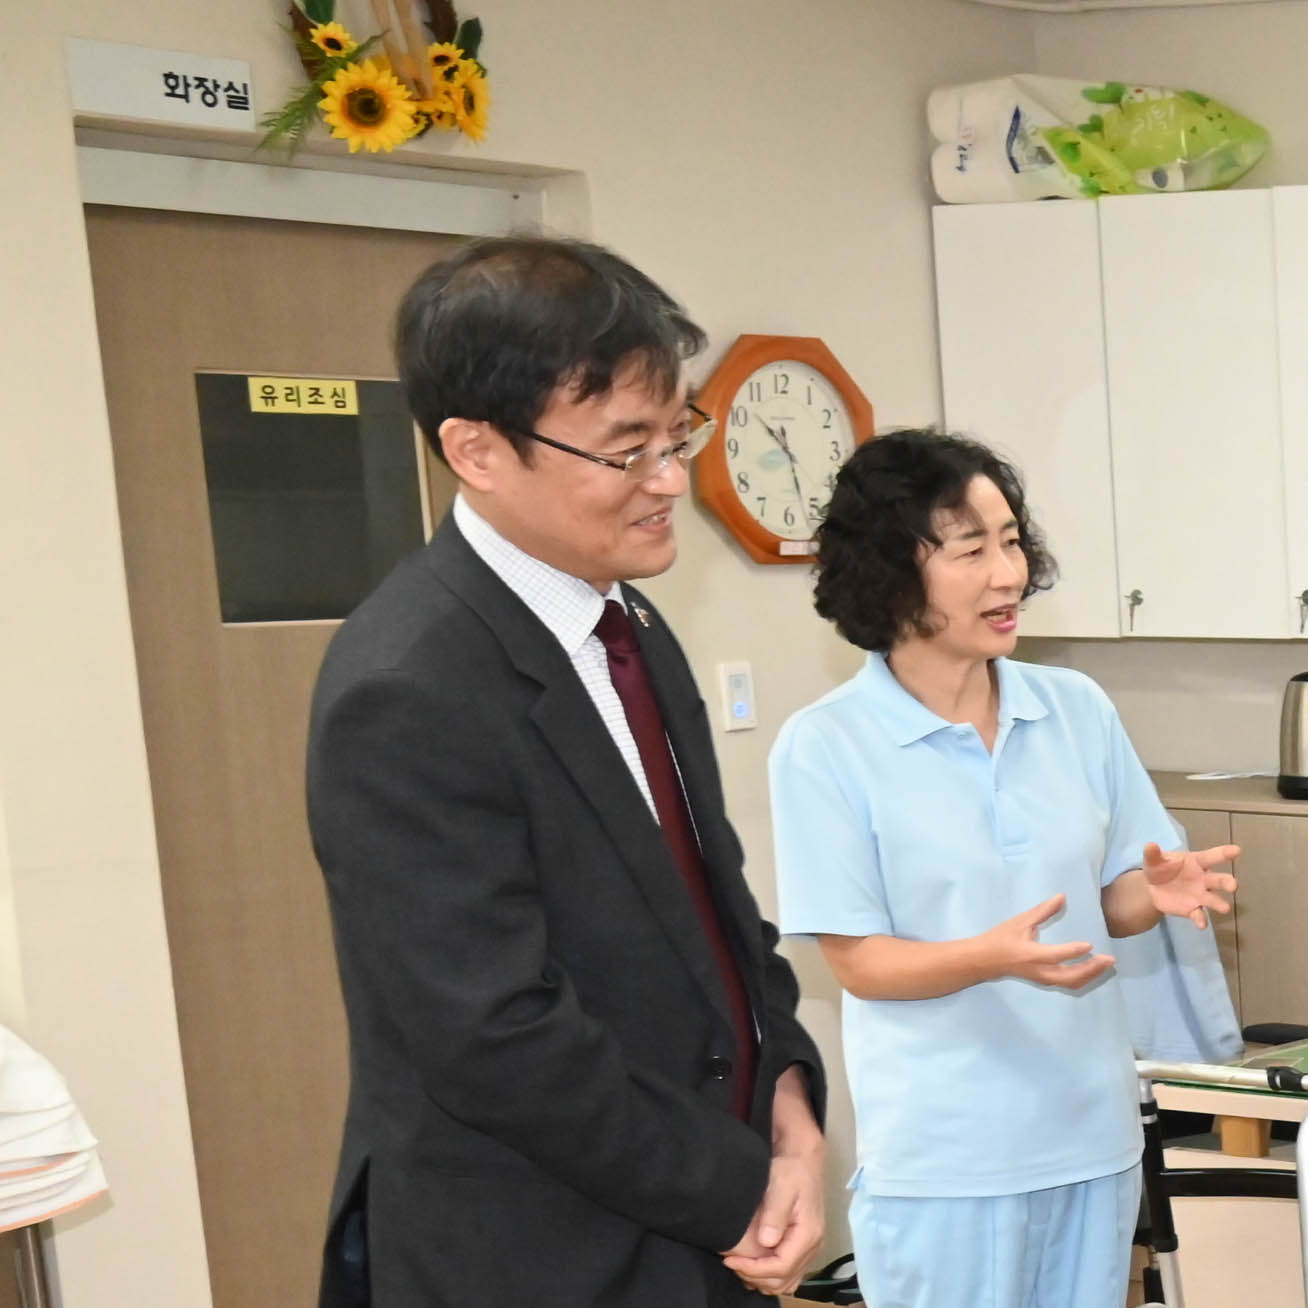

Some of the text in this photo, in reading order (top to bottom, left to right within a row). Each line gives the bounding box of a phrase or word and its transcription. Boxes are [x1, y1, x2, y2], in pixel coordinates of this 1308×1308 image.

[163, 71, 250, 111] 화장실
[750, 382, 762, 402] 11
[773, 373, 790, 395] 12
[260, 384, 347, 409] 유리조심
[730, 405, 748, 428] 10
[822, 409, 832, 429] 2
[727, 438, 739, 460] 9
[829, 440, 841, 462] 3
[736, 471, 750, 494] 8
[756, 496, 767, 518] 7
[783, 506, 795, 527] 6
